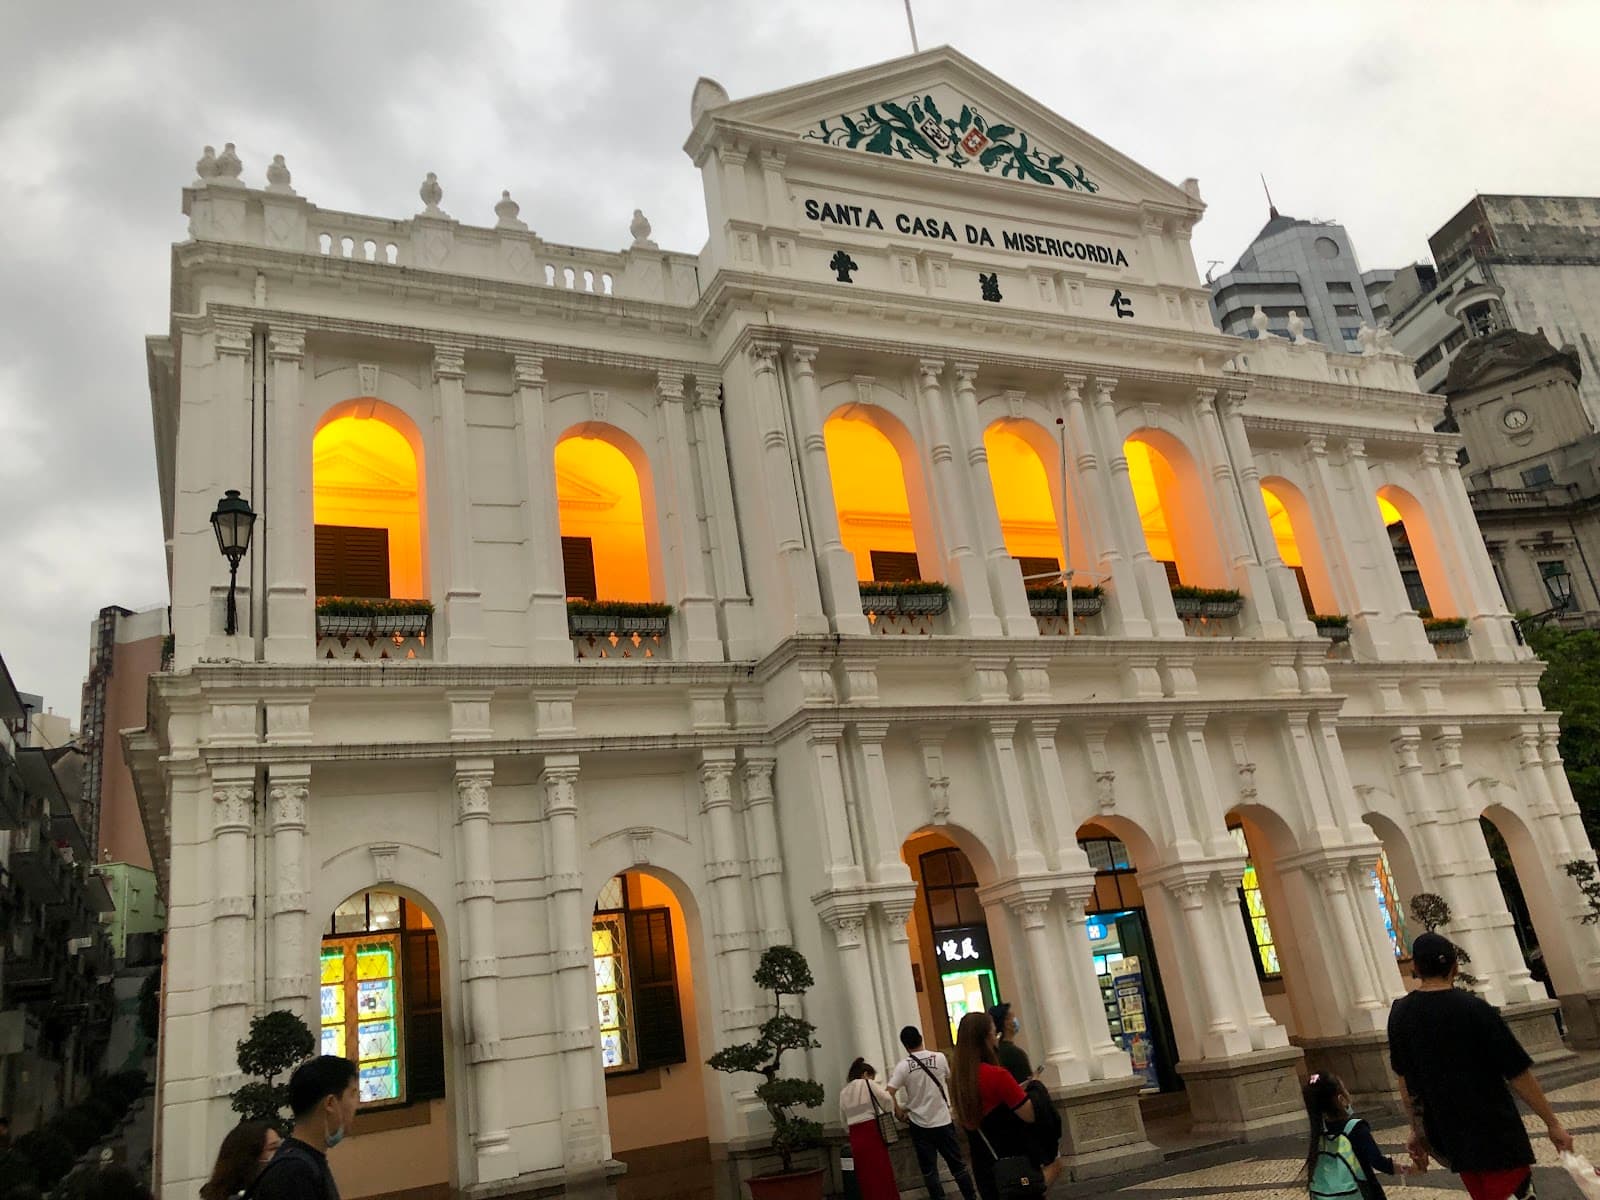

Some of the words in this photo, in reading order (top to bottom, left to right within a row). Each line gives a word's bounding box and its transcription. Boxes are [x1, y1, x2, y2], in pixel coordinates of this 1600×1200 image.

[804, 199, 884, 230] SANTA
[895, 213, 958, 242] CASA
[965, 224, 995, 248] DA
[1002, 230, 1129, 268] MISERICORDIA
